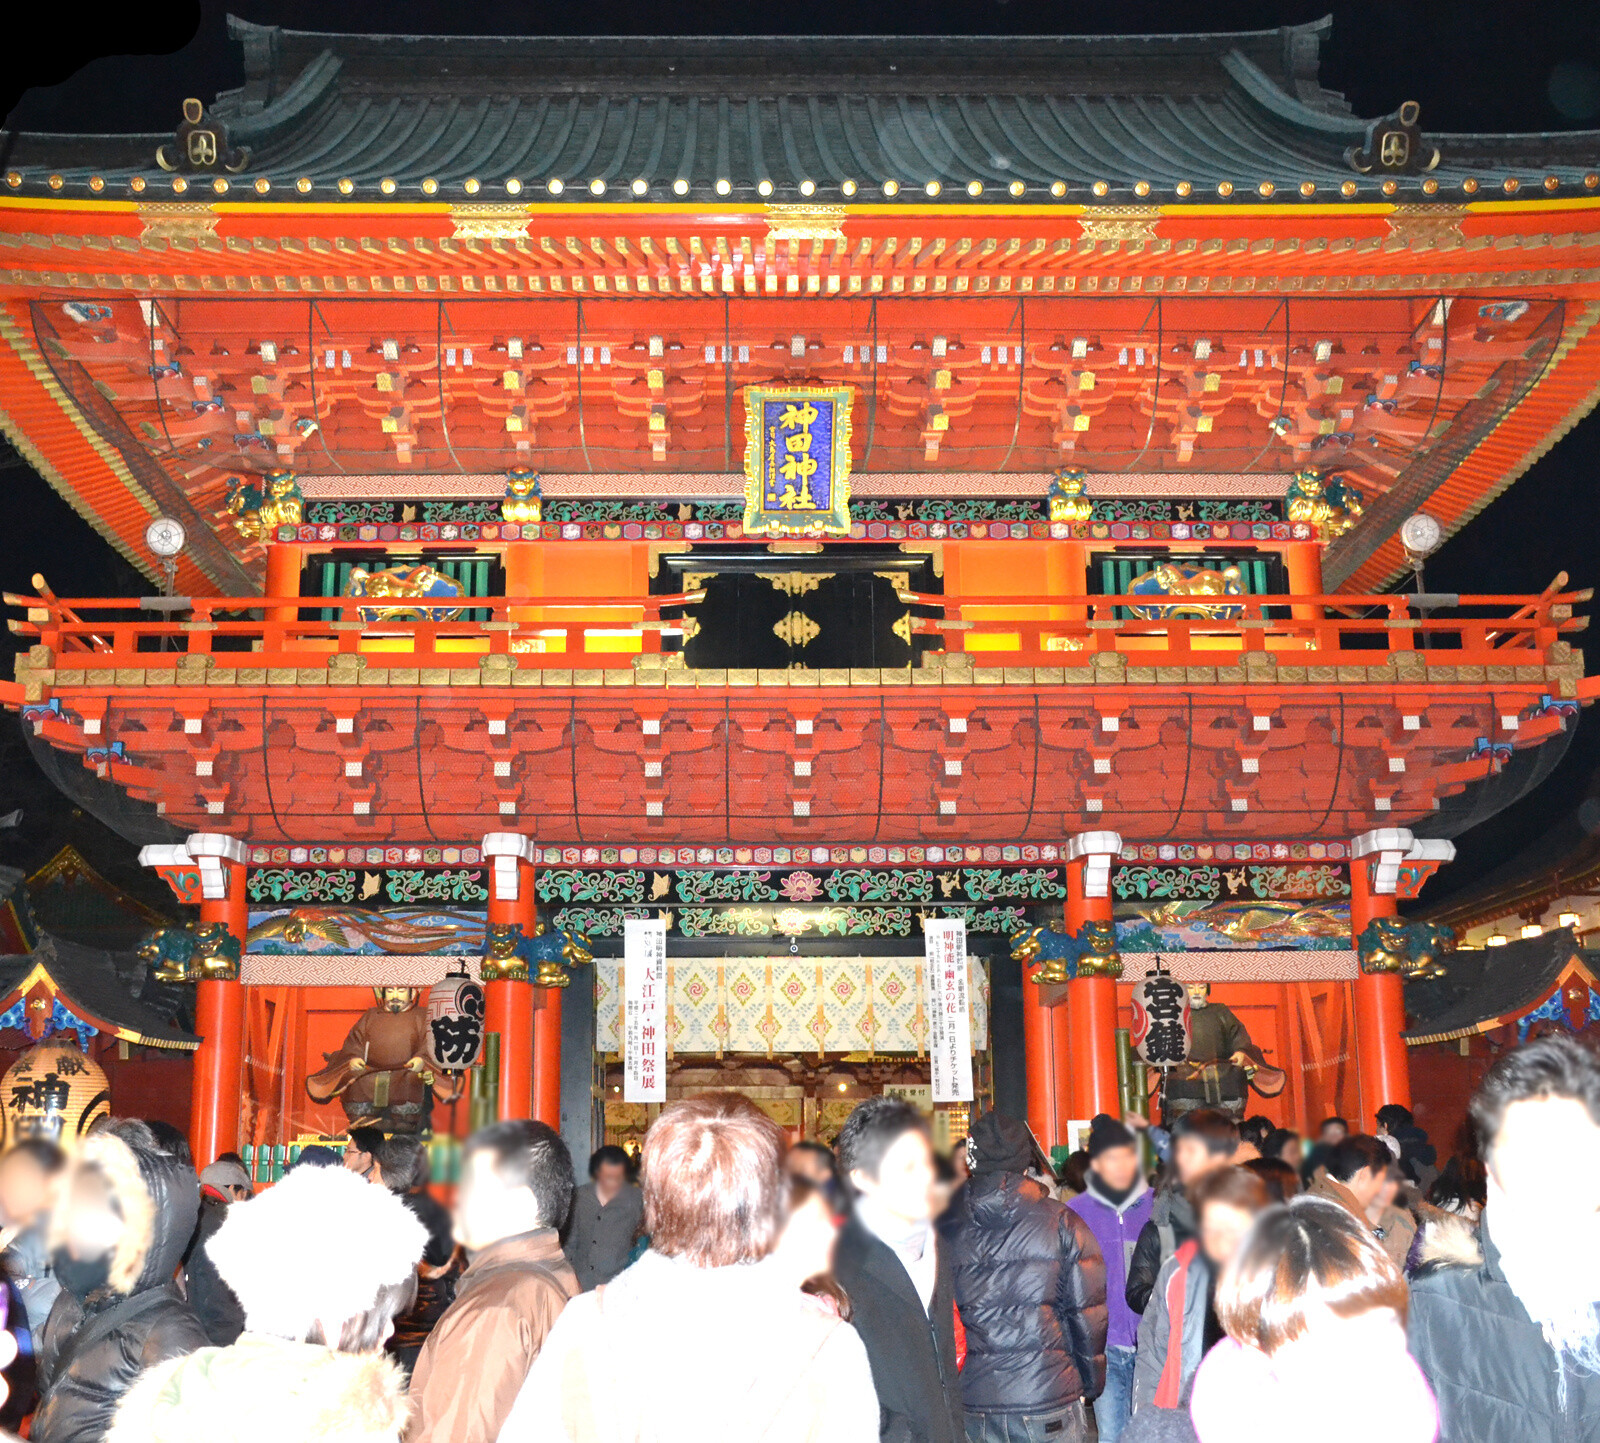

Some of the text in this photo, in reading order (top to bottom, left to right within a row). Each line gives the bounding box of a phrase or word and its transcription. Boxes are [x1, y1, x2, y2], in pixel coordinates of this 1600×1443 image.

[778, 401, 819, 510] 神田神社
[641, 966, 656, 1090] 大江戸・神田祭展
[943, 930, 960, 1097] 明神能・幽玄の花 二月一日よりチケット発売
